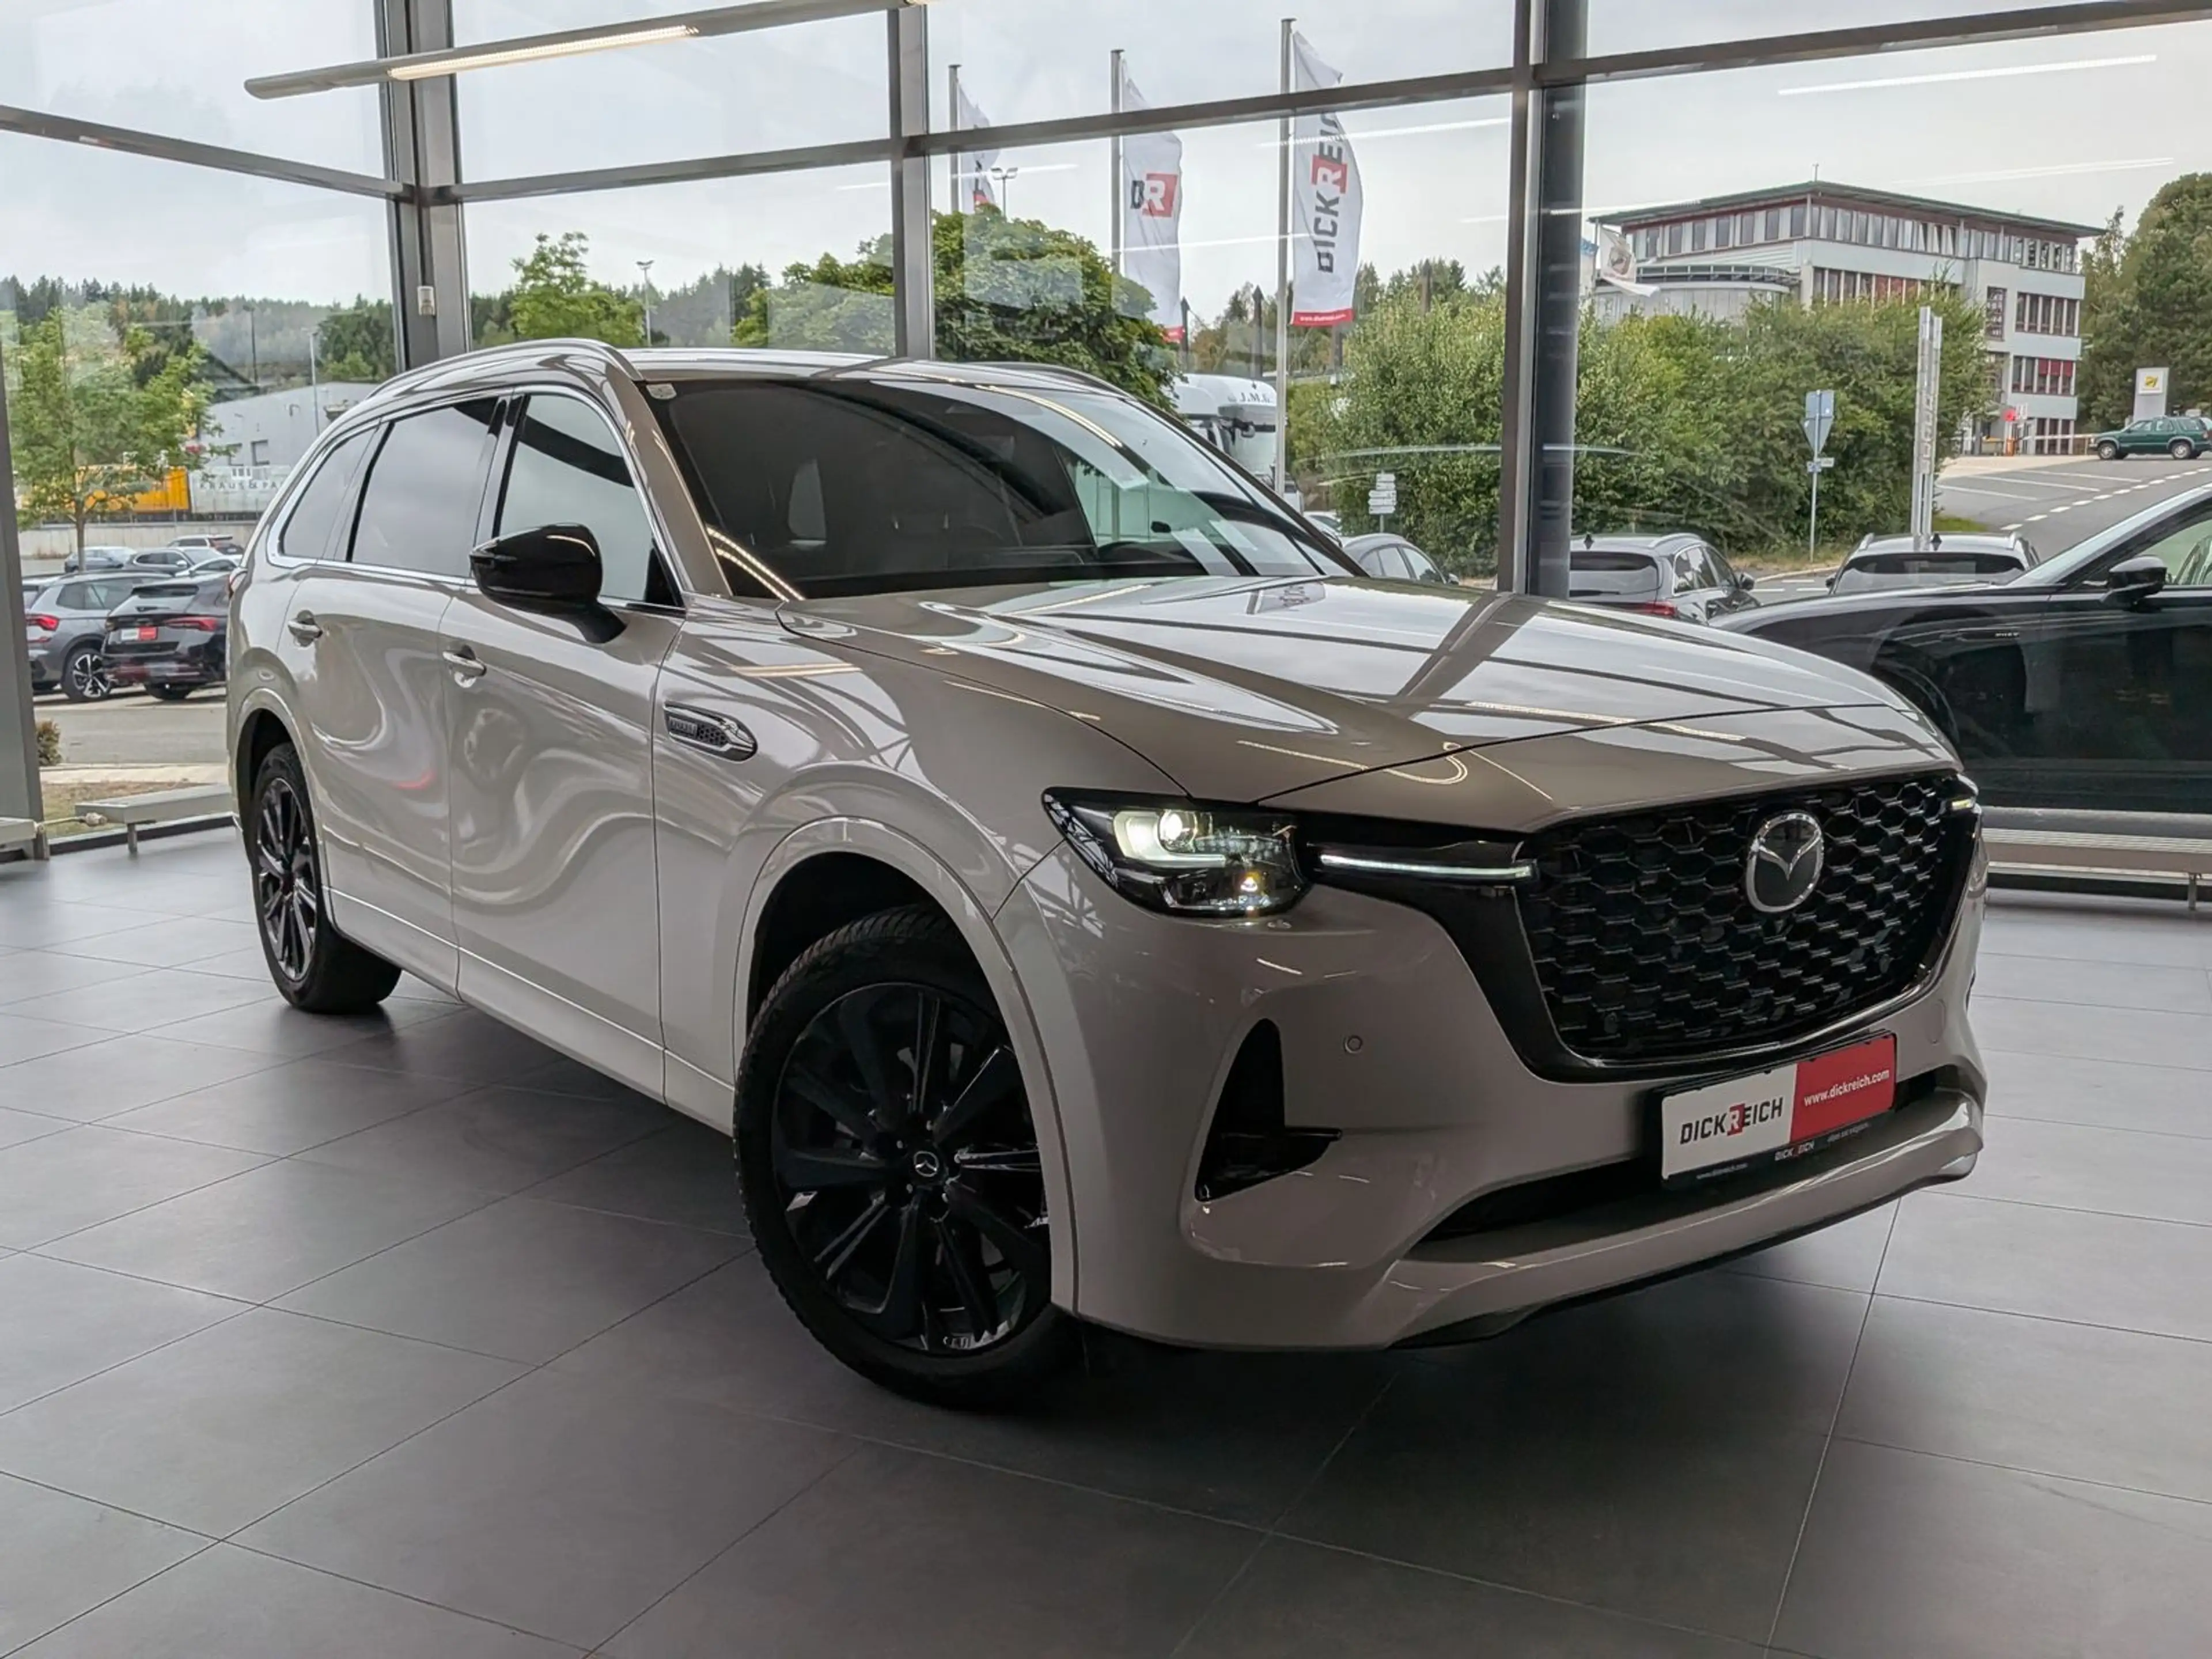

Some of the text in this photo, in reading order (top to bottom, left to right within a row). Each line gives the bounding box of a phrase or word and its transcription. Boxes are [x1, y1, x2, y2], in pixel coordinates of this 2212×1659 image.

[1312, 111, 1346, 274] DICKREIC
[1804, 1069, 1890, 1107] www.dickreich.com
[1680, 1097, 1784, 1145] DICKREICH
